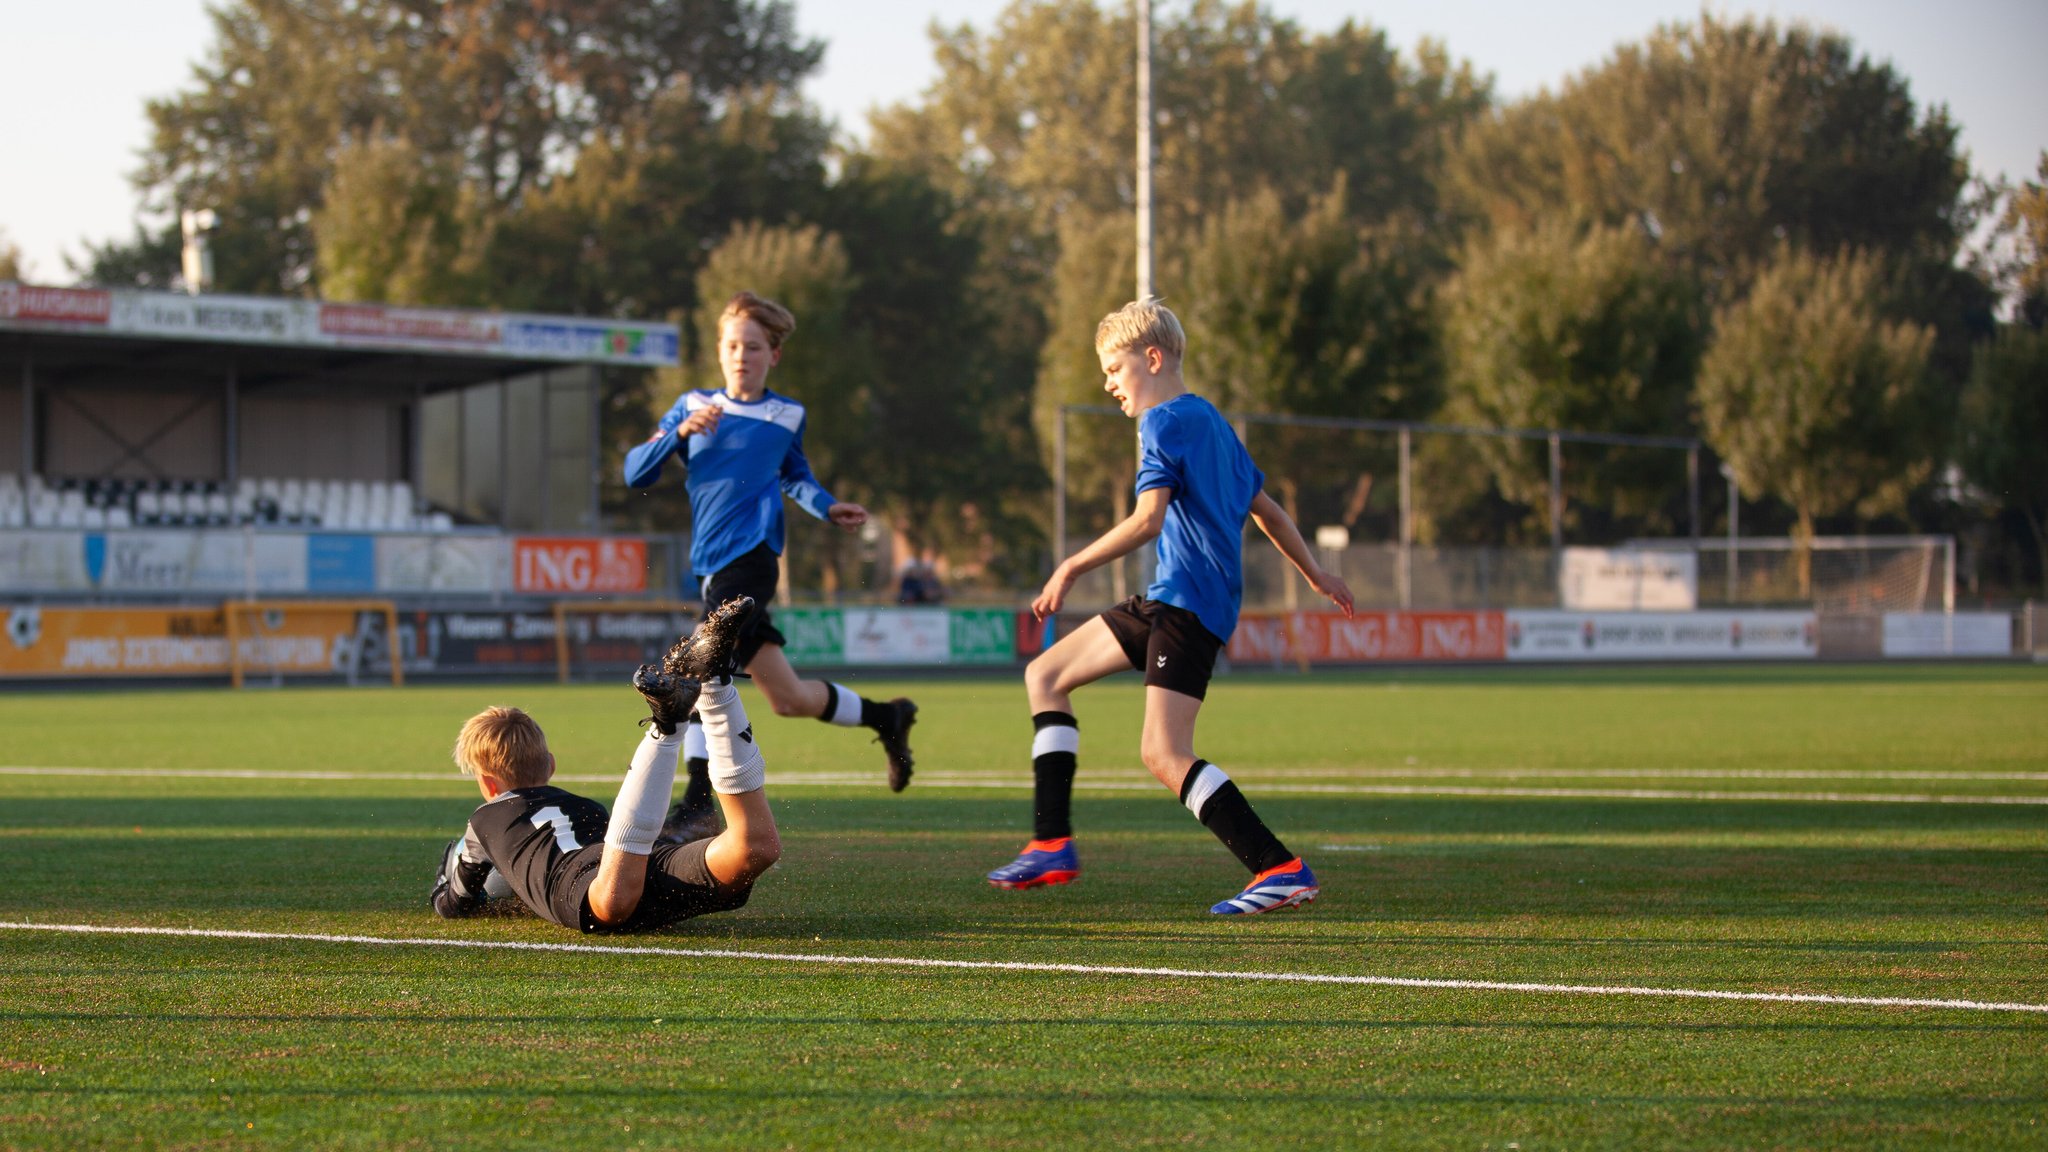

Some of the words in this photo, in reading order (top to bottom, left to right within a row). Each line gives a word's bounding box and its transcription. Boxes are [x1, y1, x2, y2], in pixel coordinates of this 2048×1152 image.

[519, 545, 591, 592] ING
[1232, 619, 1288, 658] ING
[1329, 618, 1382, 659] ING
[1421, 618, 1472, 659] ING
[530, 806, 583, 854] 1
